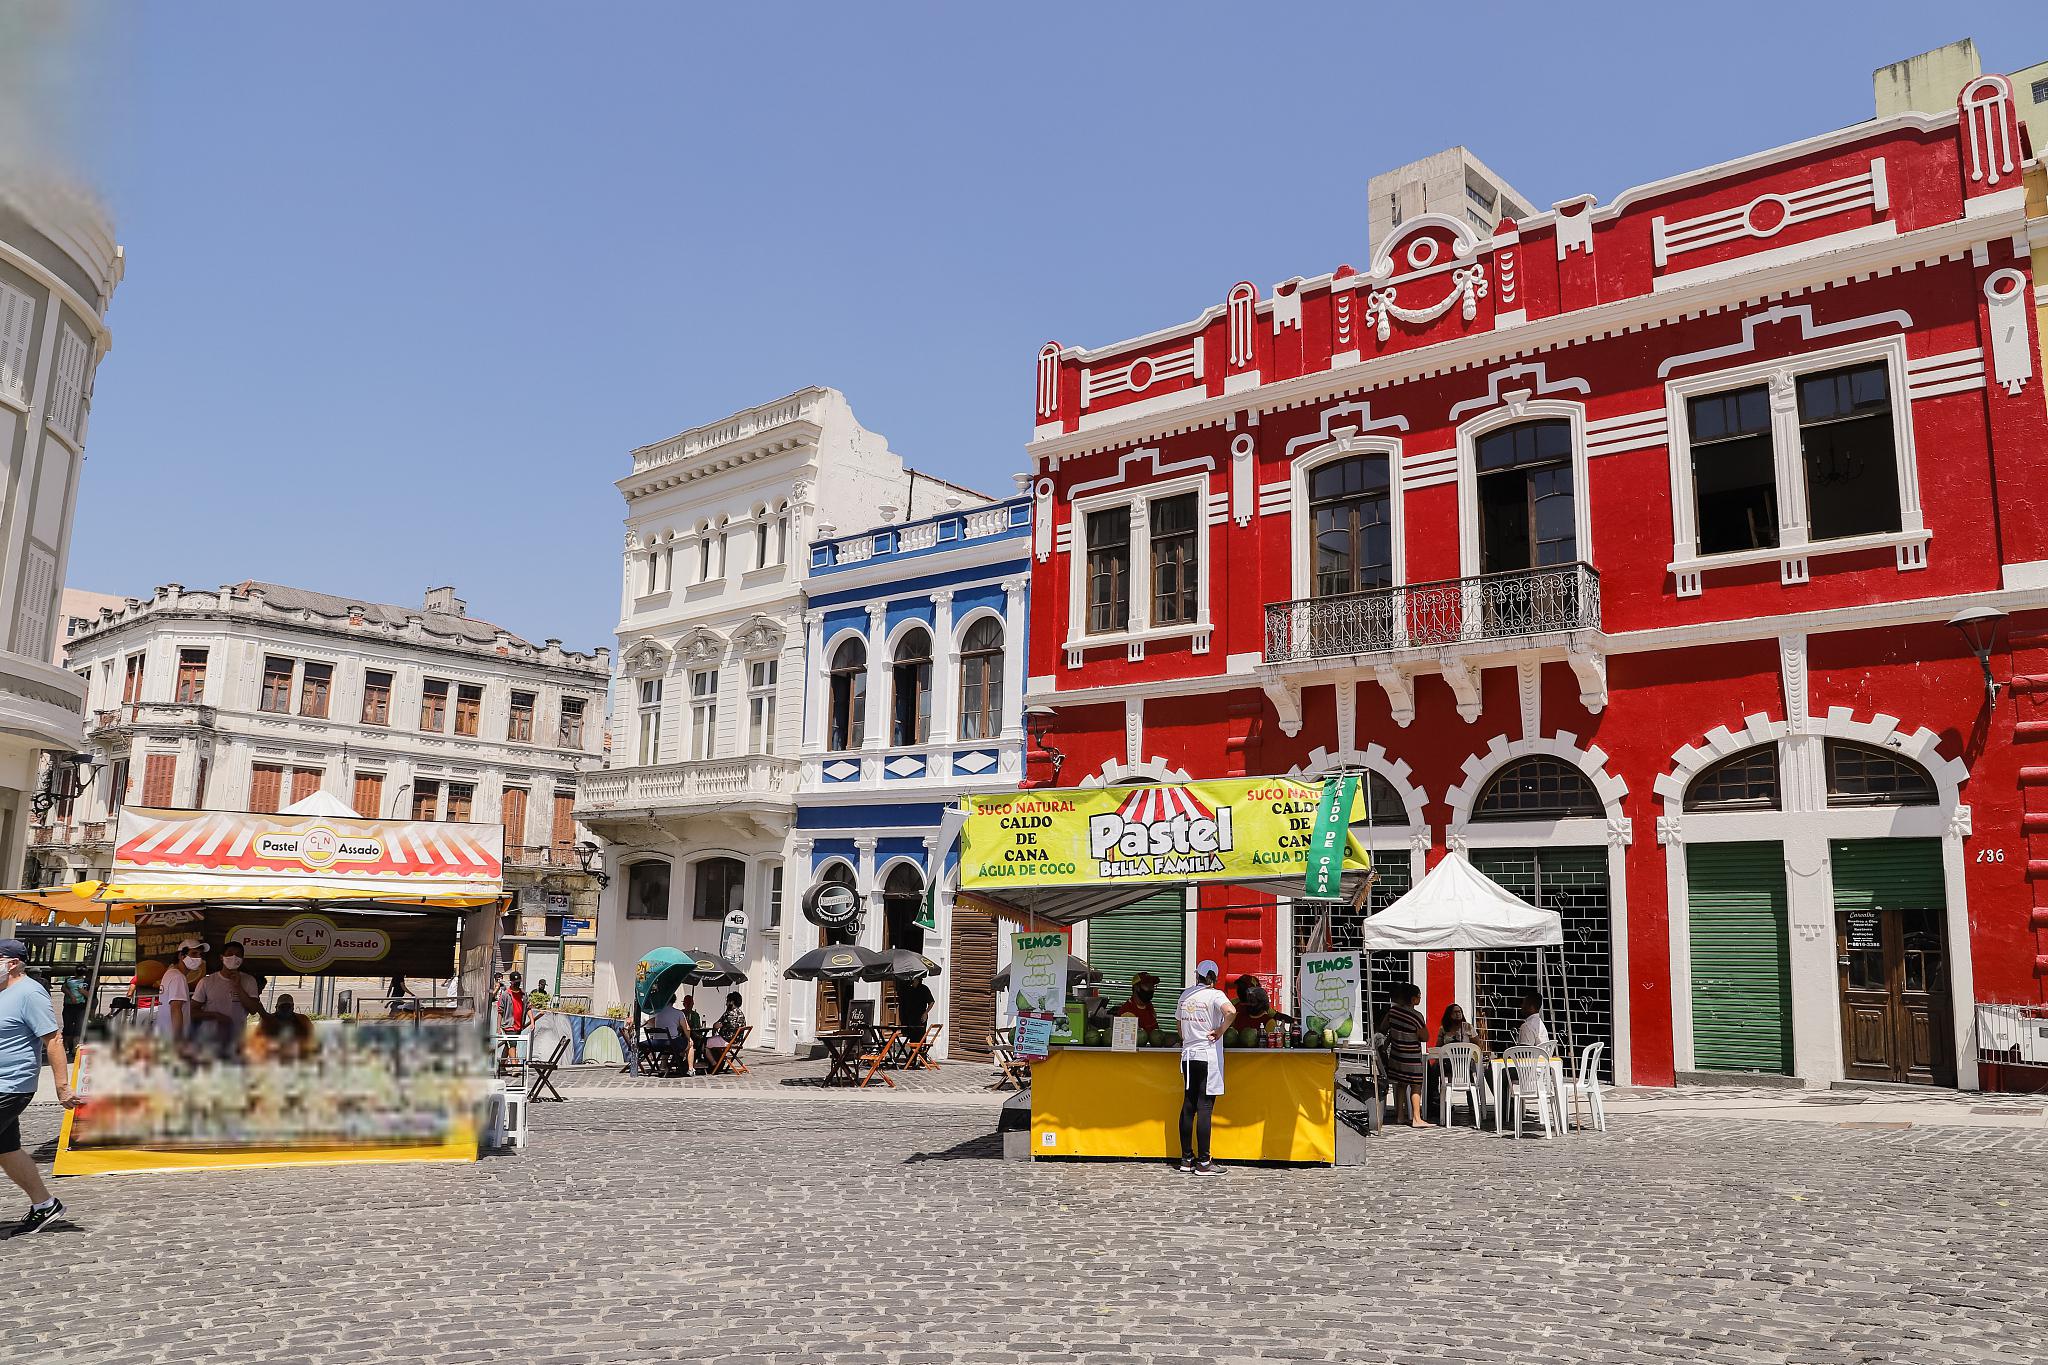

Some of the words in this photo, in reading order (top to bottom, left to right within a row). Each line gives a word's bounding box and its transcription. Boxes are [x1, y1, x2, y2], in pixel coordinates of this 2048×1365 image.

[1247, 789, 1283, 801] SUCO
[978, 804, 1012, 816] SUCO
[1016, 801, 1076, 814] NATURAL
[1000, 816, 1053, 829] CALDO
[1289, 818, 1311, 831] DE
[1016, 833, 1037, 845] DE
[1089, 806, 1233, 859] Pastel
[1324, 831, 1336, 848] DE
[262, 840, 299, 852] Pastel
[338, 843, 380, 855] Assado
[1278, 834, 1311, 848] CAN
[1004, 849, 1049, 861] CANA
[1252, 850, 1290, 864] ÁGUA
[1294, 851, 1309, 862] DE
[979, 863, 1016, 877] ÁGUA
[1019, 864, 1039, 875] DE
[1039, 862, 1076, 875] COCO
[1099, 857, 1152, 877] BELLA
[1153, 855, 1225, 875] FAMILIA
[1317, 856, 1330, 893] CANA
[848, 922, 858, 932] 51
[242, 937, 282, 947] Pastel
[333, 938, 379, 948] Assado
[1017, 934, 1062, 950] TEMOS
[1306, 956, 1354, 974] TEMOS
